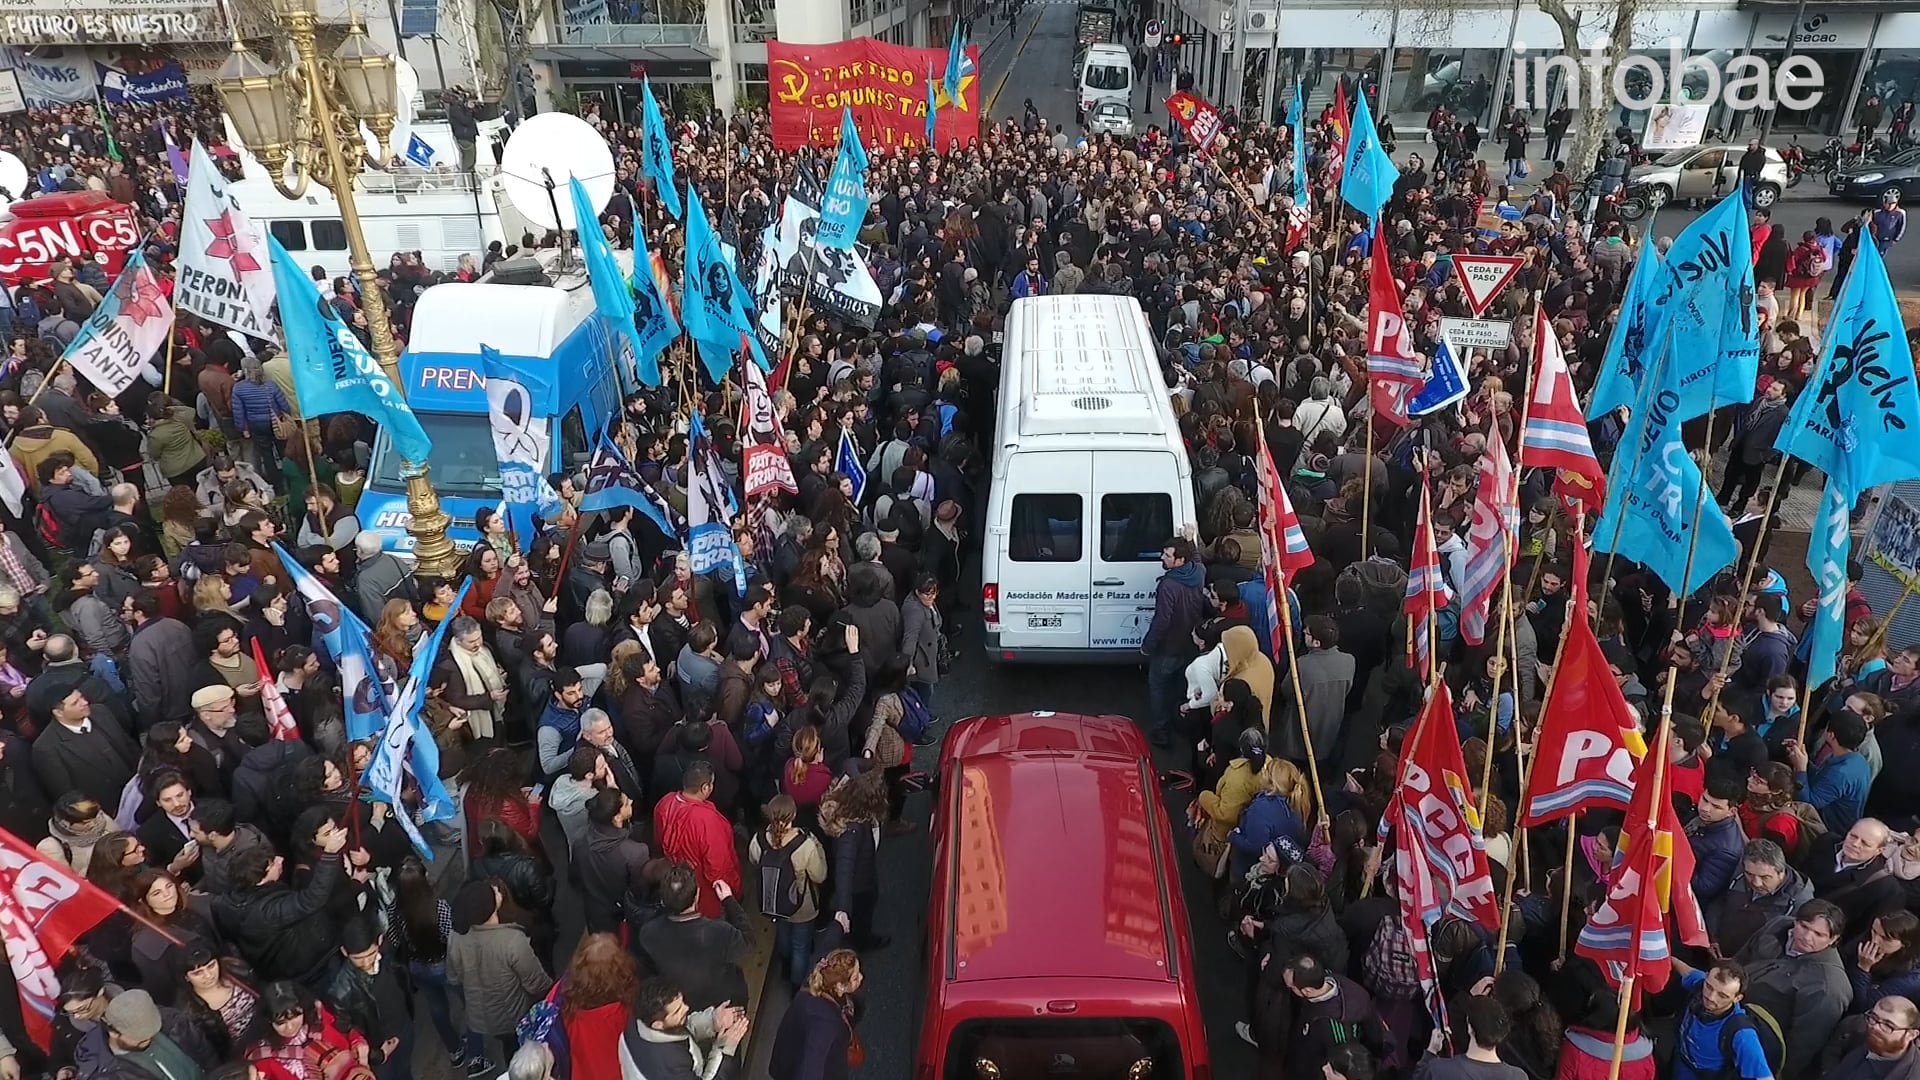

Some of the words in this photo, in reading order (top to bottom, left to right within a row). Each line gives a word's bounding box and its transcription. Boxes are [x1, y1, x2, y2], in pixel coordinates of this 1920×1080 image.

[5, 14, 78, 36] FUTURO
[82, 14, 108, 35] ES
[112, 13, 197, 37] NUESTRO
[1795, 34, 1837, 42] secac
[810, 86, 928, 119] COMUNISTA
[0, 221, 80, 273] C5N
[1467, 266, 1492, 274] CEDA
[1493, 266, 1504, 274] EL
[1472, 274, 1497, 282] PASO
[92, 313, 141, 368] ONISMO
[77, 331, 134, 391] TANTE
[1852, 318, 1909, 434] Vuelve
[1804, 419, 1835, 442] PARA
[1006, 591, 1053, 600] Asociación
[1056, 591, 1089, 600] Madres
[1092, 591, 1104, 599] de
[1107, 591, 1131, 599] Plaza
[1134, 591, 1146, 599] de
